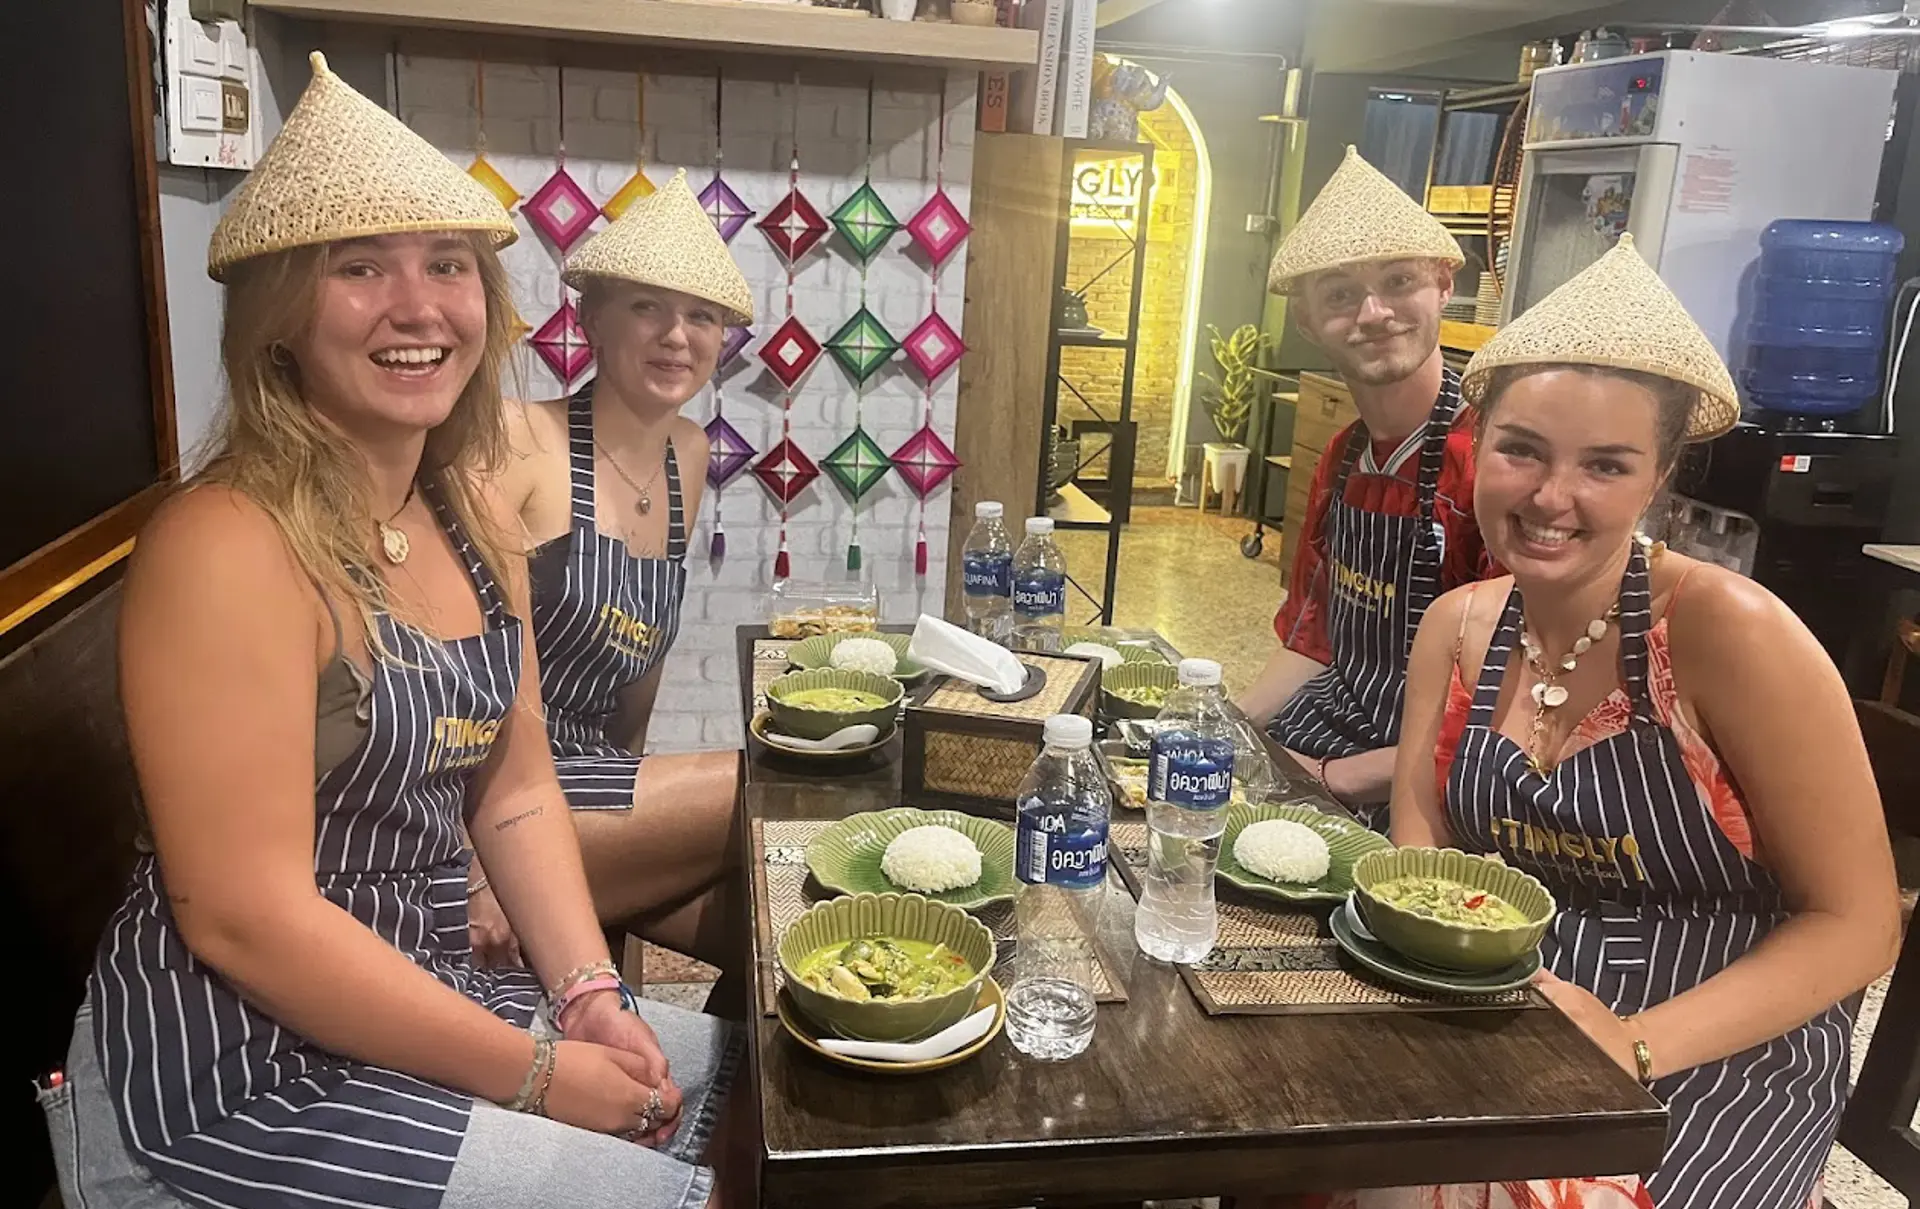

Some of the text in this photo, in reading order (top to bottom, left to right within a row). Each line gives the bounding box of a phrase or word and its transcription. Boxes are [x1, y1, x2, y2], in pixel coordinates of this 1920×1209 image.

[1043, 33, 1057, 86] FASHION
[1072, 70, 1086, 111] WHITE
[1077, 167, 1142, 197] GLY
[964, 573, 999, 587] QUAFINA
[445, 717, 499, 748] TING
[1502, 818, 1618, 863] TINGLY
